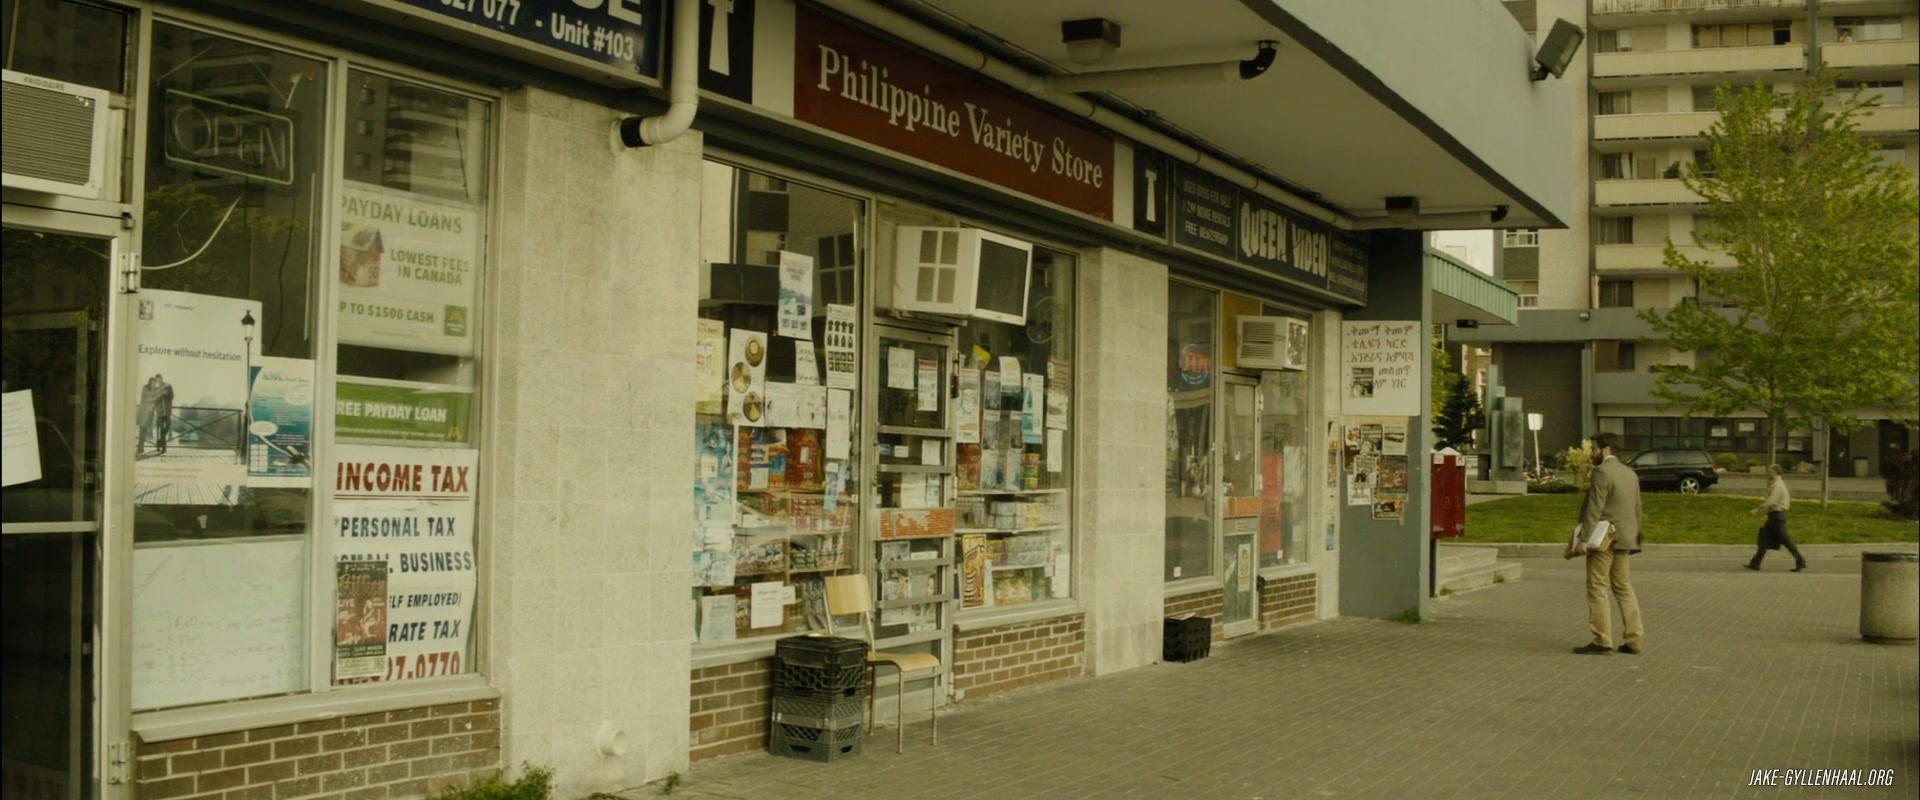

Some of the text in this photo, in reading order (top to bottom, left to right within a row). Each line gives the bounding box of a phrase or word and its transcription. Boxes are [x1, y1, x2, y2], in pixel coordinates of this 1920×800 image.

[552, 12, 589, 49] Unit
[593, 26, 635, 61] #103
[817, 44, 1102, 188] Philippine Variety Store
[174, 104, 288, 171] OPEN
[408, 208, 463, 234] LOANS
[1185, 220, 1198, 236] FREE
[1241, 201, 1328, 278] QUEEN VIDEO
[390, 249, 470, 273] LOWEST FEES
[398, 265, 463, 286] IN CANADA
[350, 302, 365, 315] TO
[368, 304, 404, 320] $1500
[406, 309, 435, 324] CASH
[138, 344, 242, 361] Explore without hesitation
[336, 400, 448, 423] REE PAYDAY LOAN
[336, 462, 470, 493] INCOME TAX
[340, 516, 456, 537] PERSONAL TAX
[400, 551, 472, 574] BUSINESS
[388, 619, 463, 643] RATE TAX
